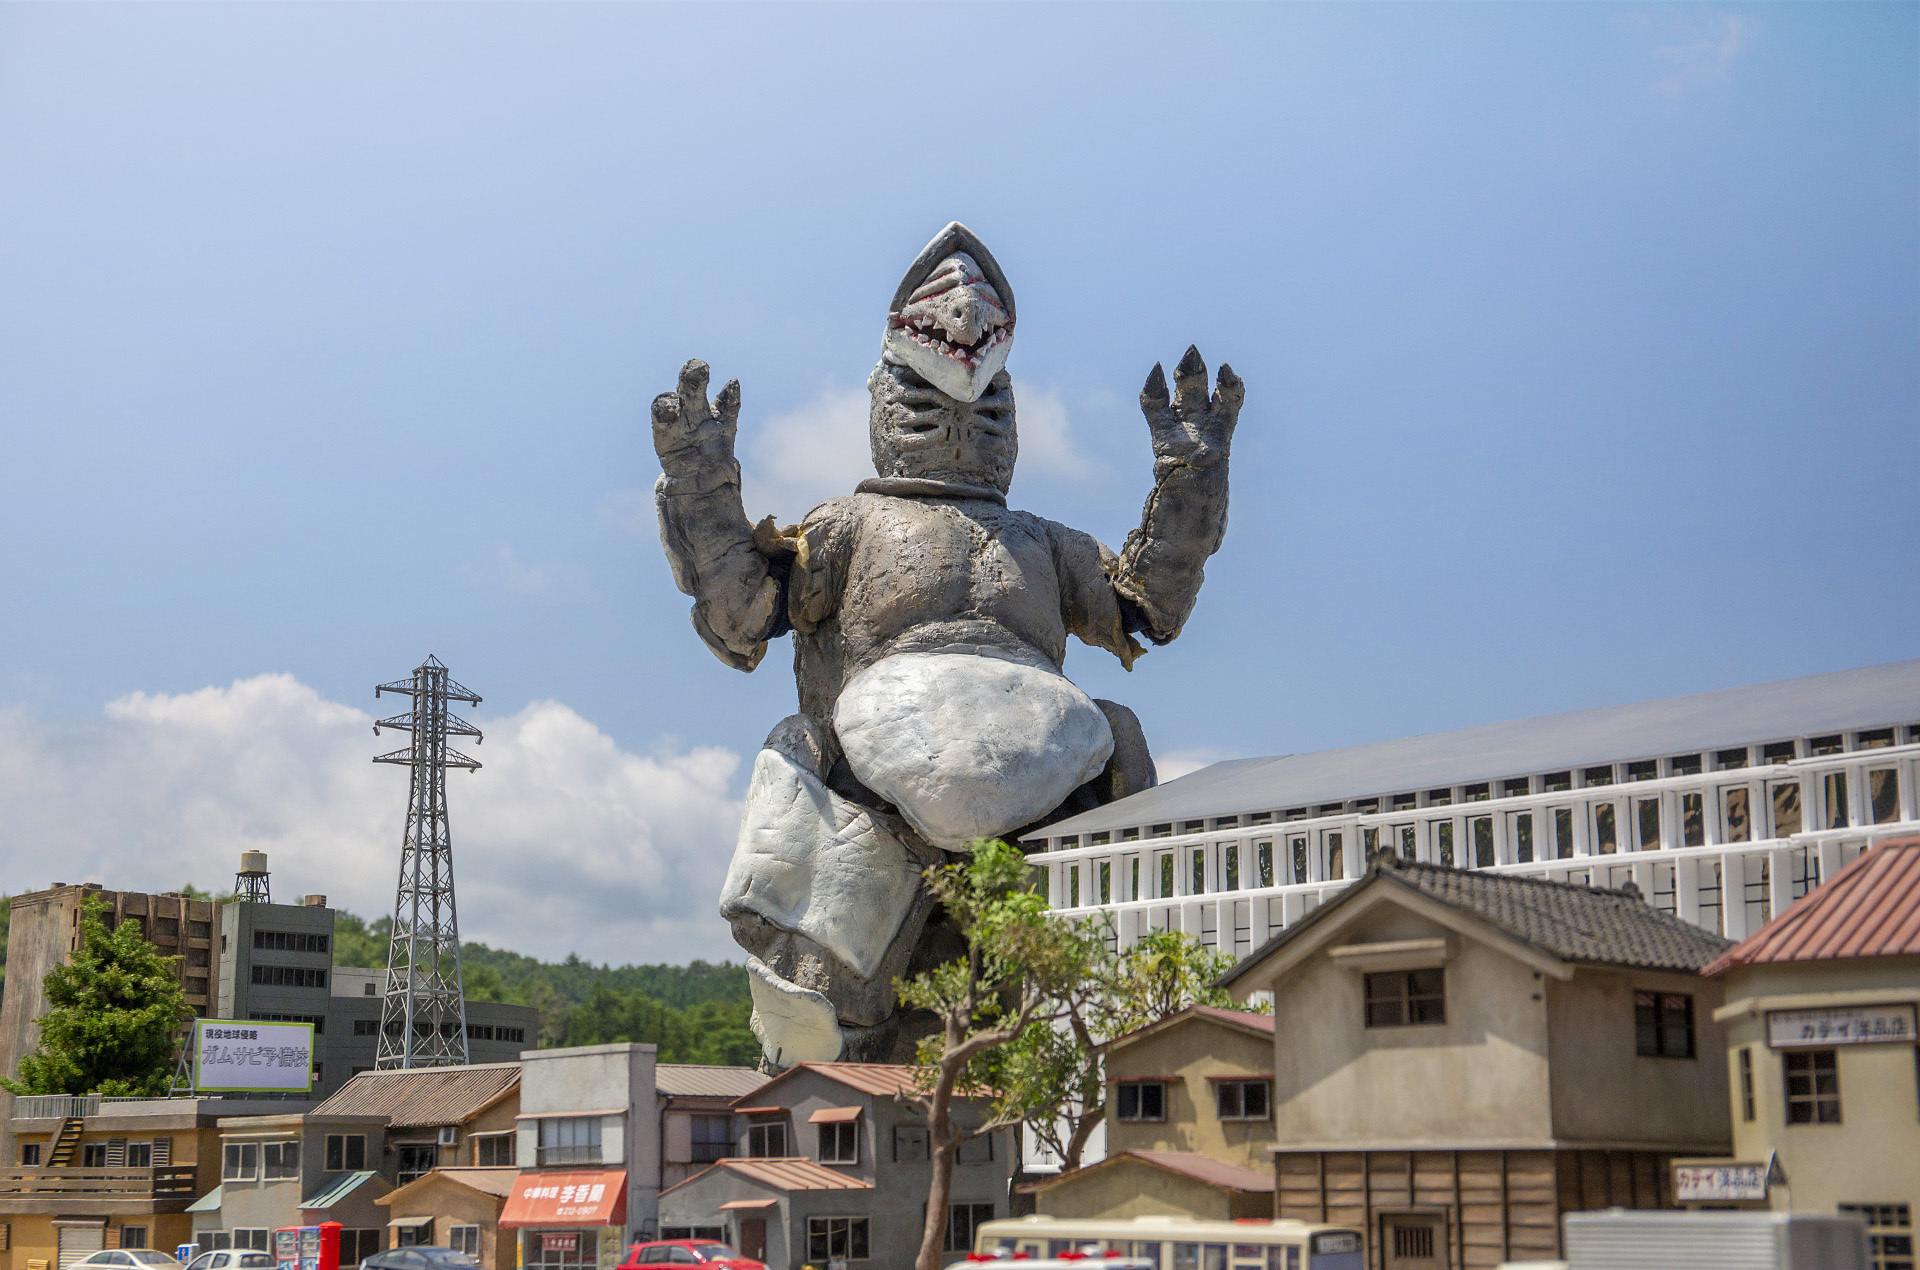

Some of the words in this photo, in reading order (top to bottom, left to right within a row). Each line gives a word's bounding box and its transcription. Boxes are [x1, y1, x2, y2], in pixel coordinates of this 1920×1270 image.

[205, 1028, 258, 1041] 現役地球侵略
